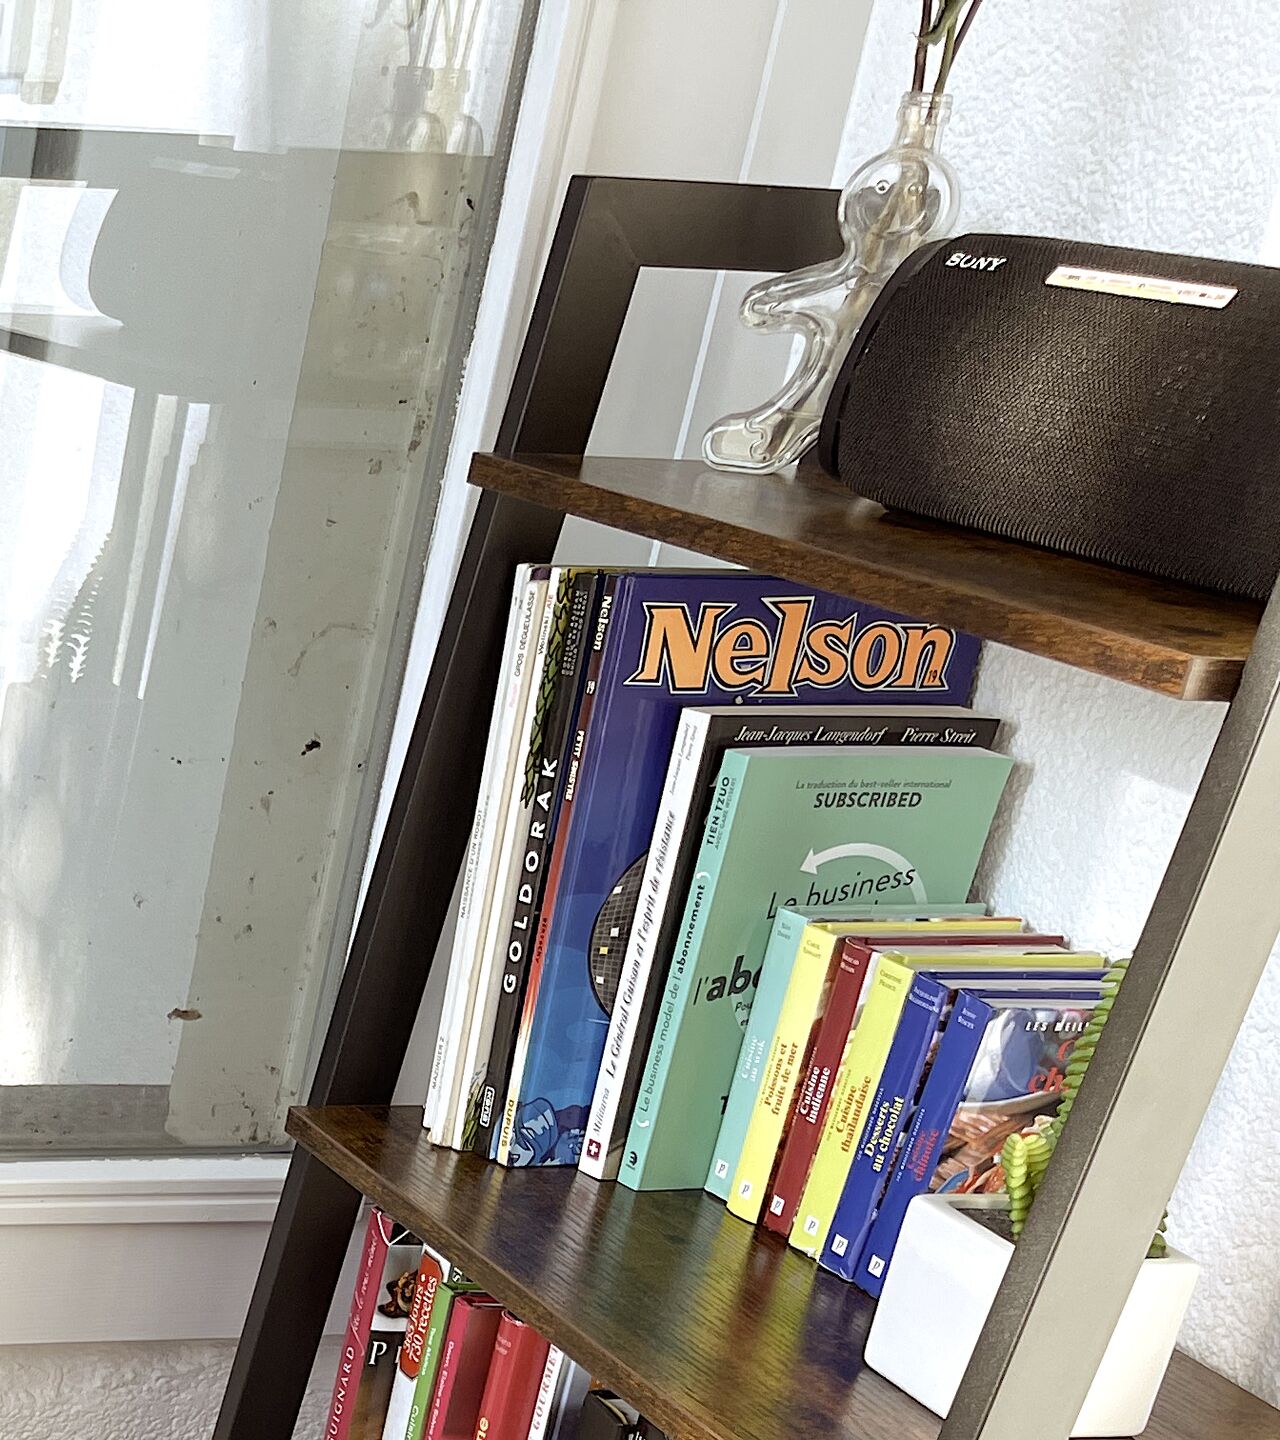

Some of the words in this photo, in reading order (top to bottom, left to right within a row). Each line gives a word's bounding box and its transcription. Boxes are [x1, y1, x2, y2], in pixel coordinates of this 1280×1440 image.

[593, 595, 612, 651] Nelson
[623, 596, 955, 697] Nelson
[734, 726, 813, 745] Jean-Jacques
[814, 726, 888, 744] Langendorf
[901, 727, 939, 743] Pierre
[940, 727, 977, 744] Streit
[796, 780, 805, 790] La
[807, 780, 846, 790] traduction
[848, 780, 859, 789] du
[813, 792, 922, 809] SUBSCRIBED
[706, 815, 720, 846] TIEN
[715, 776, 731, 813] TZUO
[656, 810, 677, 876] résistance
[503, 758, 558, 993] GOLDORAK
[651, 877, 661, 896] de
[806, 867, 917, 907] business
[640, 893, 656, 936] l'esprit
[675, 884, 706, 982] l'abonnement
[635, 936, 645, 957] et
[624, 959, 641, 1006] Guisan
[671, 982, 680, 1000] de
[611, 1003, 630, 1061] Général
[660, 1002, 675, 1042] model
[1025, 1021, 1049, 1032] LES
[606, 1060, 617, 1080] Le
[646, 1043, 664, 1095] business
[764, 1055, 783, 1108] Poissons
[779, 1043, 788, 1055] et
[771, 1085, 787, 1116] fruits
[781, 1069, 791, 1084] de
[787, 1042, 799, 1068] mer
[800, 1066, 820, 1115] Cuisine
[592, 1087, 609, 1136] Militaria
[640, 1096, 650, 1113] Le
[806, 1067, 831, 1124] indienne
[836, 1085, 857, 1134] Cuisine
[501, 1100, 515, 1147] DUPUIS
[864, 1101, 891, 1158] Desserts
[872, 1155, 884, 1174] au
[878, 1095, 905, 1156] chocolat
[409, 1285, 424, 1327] jours
[409, 1334, 424, 1363] 730
[418, 1276, 438, 1334] recettes
[532, 1345, 561, 1431] GOURMET
